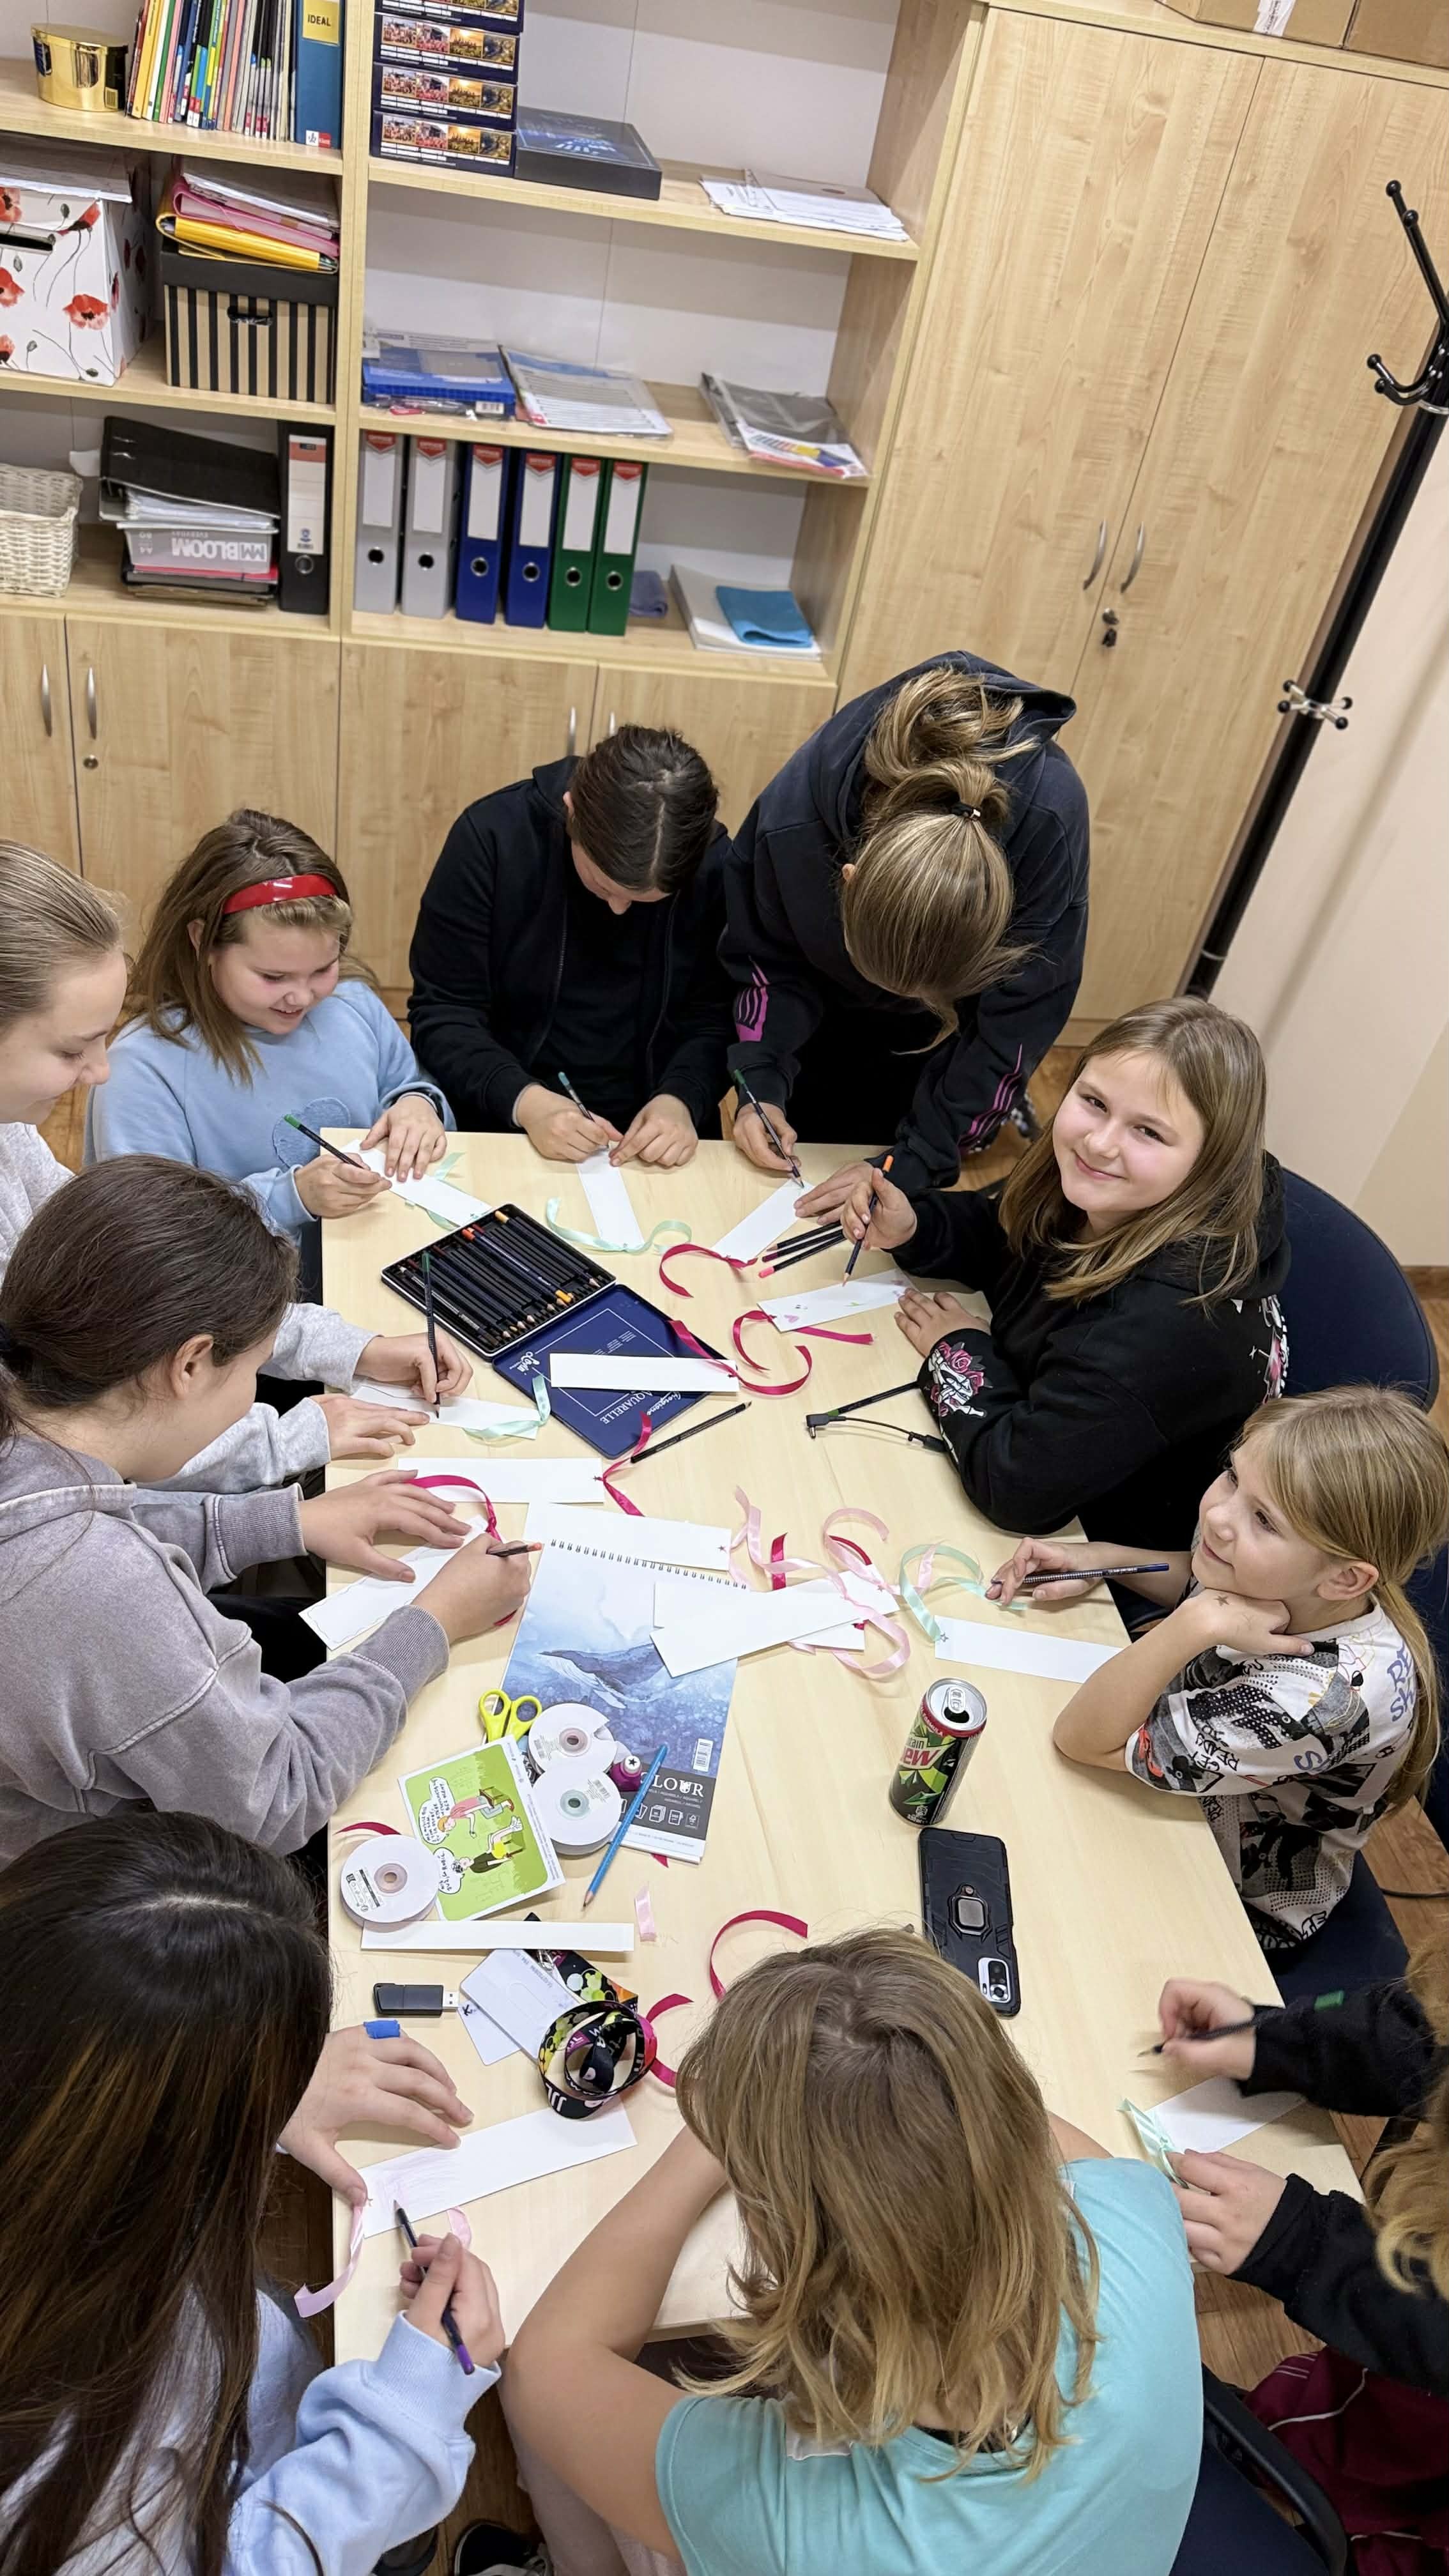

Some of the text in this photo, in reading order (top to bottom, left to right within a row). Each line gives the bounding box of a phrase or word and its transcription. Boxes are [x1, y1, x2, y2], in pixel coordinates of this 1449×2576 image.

[307, 14, 332, 27] IDEAL
[171, 538, 239, 560] BLOOM
[599, 1390, 653, 1425] AQUARELLE
